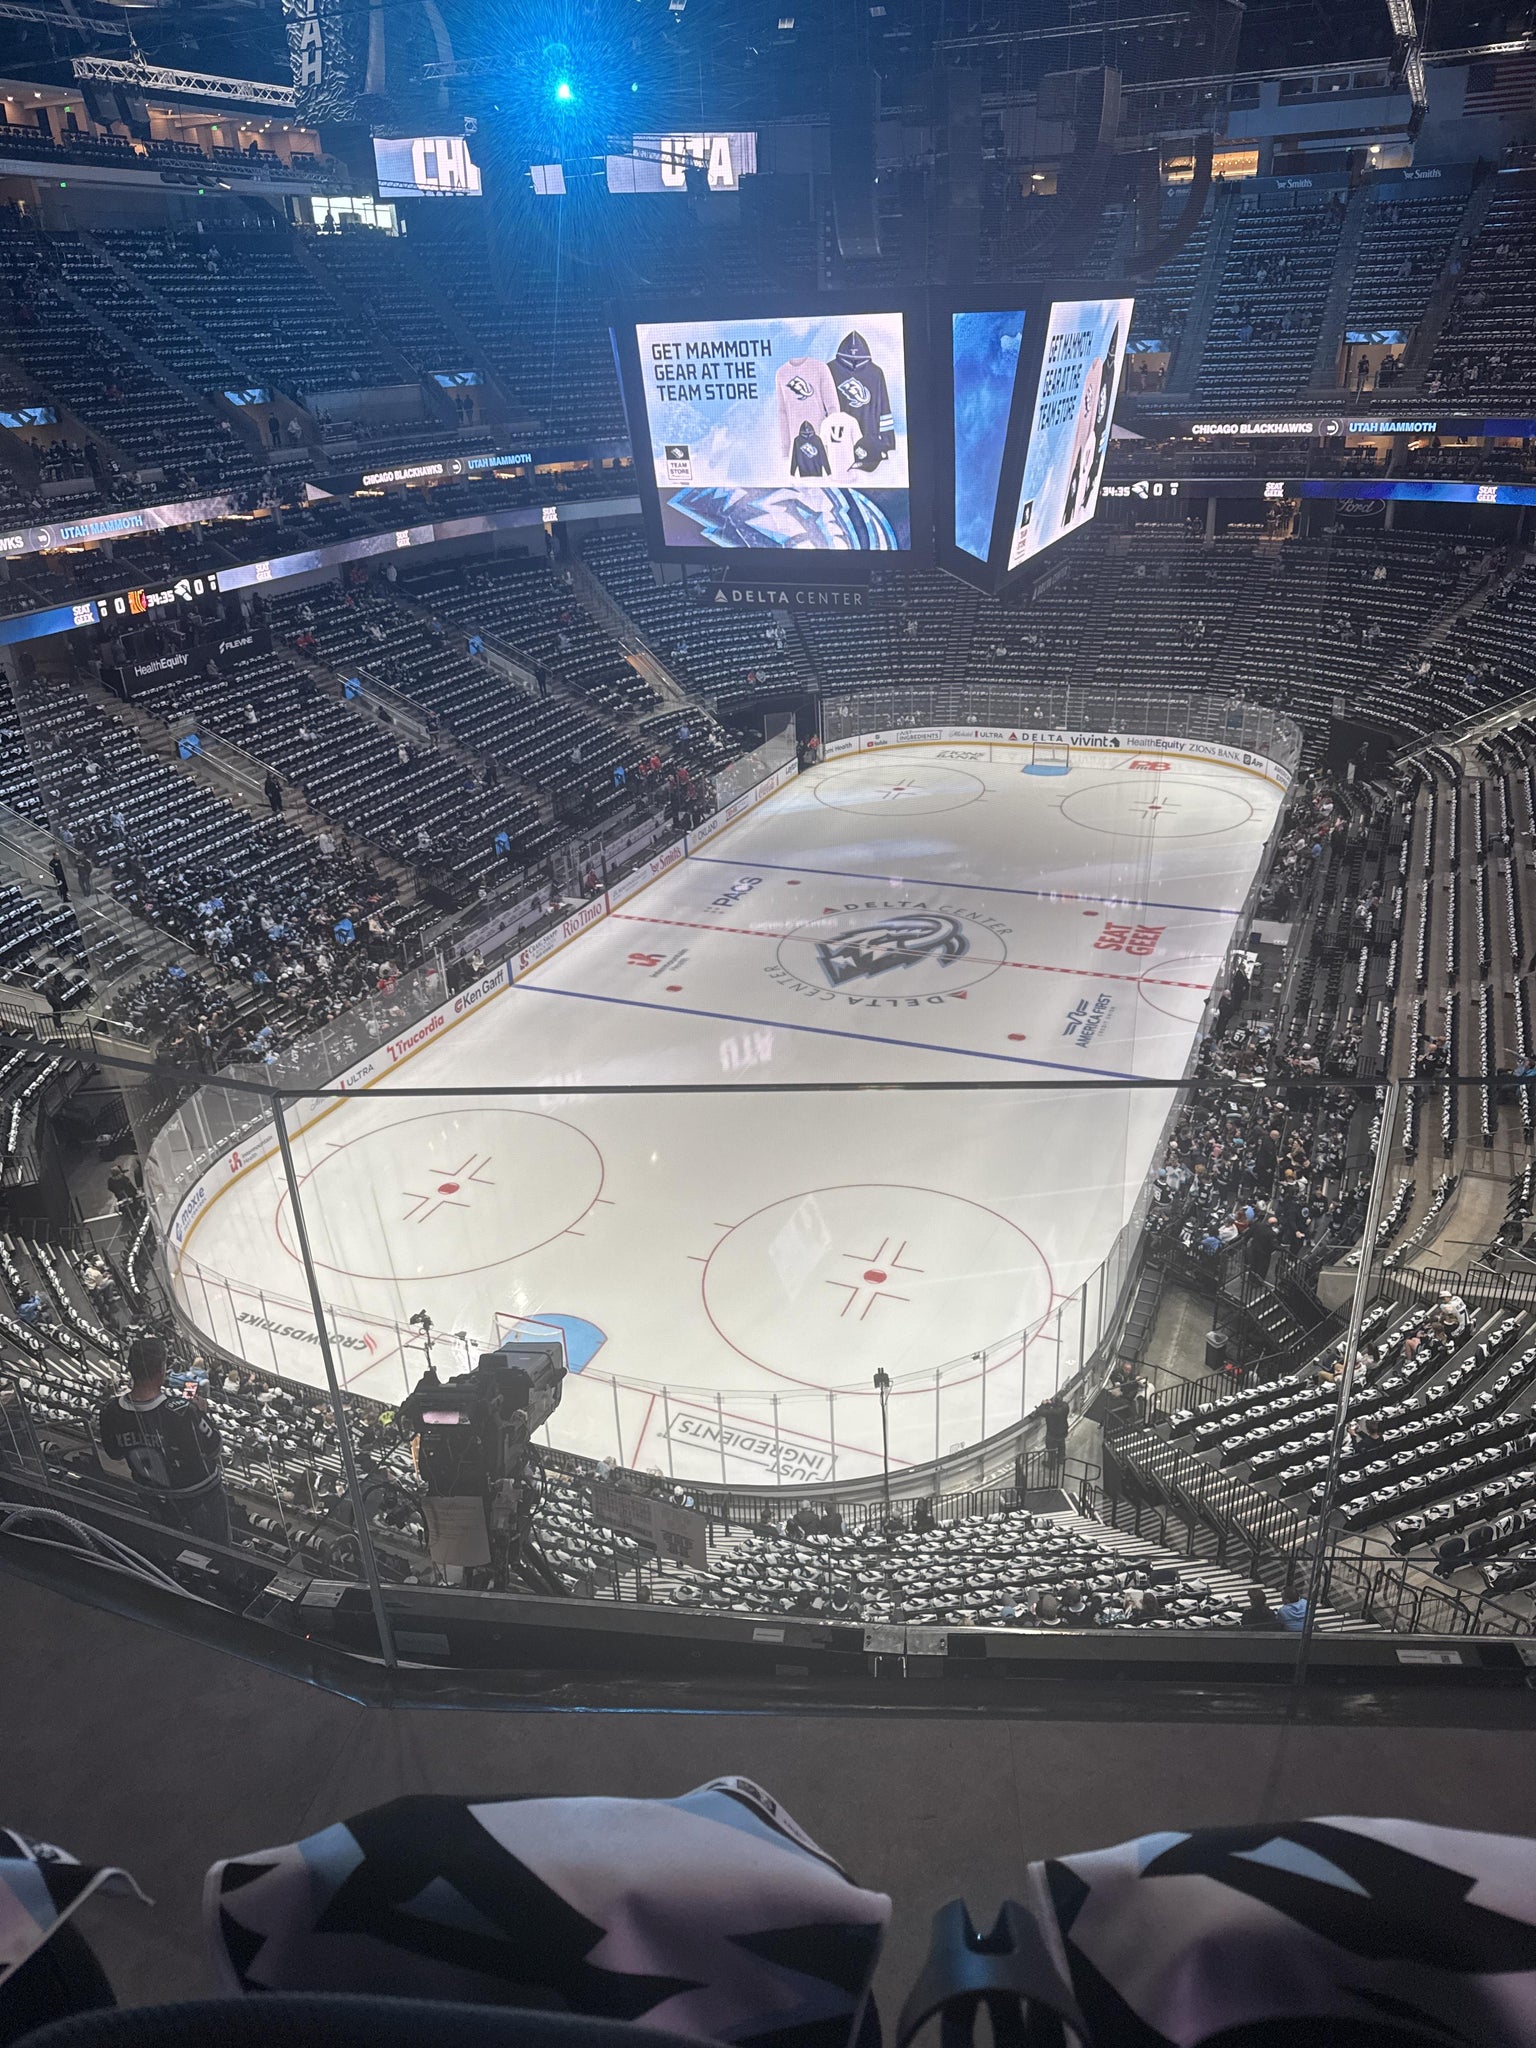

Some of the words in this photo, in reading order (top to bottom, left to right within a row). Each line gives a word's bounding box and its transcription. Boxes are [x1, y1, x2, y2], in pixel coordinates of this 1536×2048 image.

[652, 343, 681, 360] GET
[686, 339, 772, 359] MAMMOTH
[1048, 334, 1063, 363] GET
[654, 363, 697, 381] GEAR
[702, 363, 720, 379] AT
[724, 362, 756, 379] THE
[656, 384, 701, 401] TEAM
[705, 383, 758, 400] STORE
[1192, 424, 1239, 434] CHICAGO
[1240, 423, 1313, 434] BLACKHAWKS
[1349, 423, 1377, 432] UTAH
[1379, 423, 1437, 432] MAMMOTH
[468, 459, 489, 469] UTAH
[489, 453, 532, 467] MAMMOTH
[362, 471, 394, 486] CHICAGO
[394, 463, 443, 481] BLACKHAWKS
[1102, 486, 1130, 497] 34:35
[1153, 483, 1163, 496] 0
[1264, 489, 1284, 497] GEEK
[1266, 482, 1284, 490] SEAT
[1479, 486, 1498, 495] SEAT
[1336, 497, 1374, 512] Ford
[1477, 494, 1497, 502] GEEK
[60, 524, 90, 540] UTAH
[90, 515, 143, 535] MAMMOTH
[114, 597, 126, 614] 0
[147, 590, 175, 607] 34:35
[194, 579, 204, 595] 0
[732, 590, 789, 604] DELTA
[795, 591, 863, 606] CENTER
[72, 603, 90, 615] SEAT
[225, 635, 253, 650] FILEVINE
[134, 653, 189, 676] HealthEquity
[980, 731, 1003, 739] ULTRA
[1022, 732, 1063, 742] DELTA
[1127, 737, 1184, 751] HealthEquity
[1188, 743, 1216, 756] ZIONS
[1217, 749, 1240, 761] BANK
[659, 847, 682, 870] Smith's
[844, 901, 927, 910] DELTA
[939, 905, 1013, 935] CENTER
[1093, 921, 1133, 951] SEAT
[1125, 924, 1167, 956] GEEK
[463, 988, 482, 1009] Ken
[482, 968, 504, 996] Garff
[764, 965, 836, 1000] CENTER
[848, 996, 947, 1007] DELTA
[1075, 1014, 1101, 1048] AMERICA
[1096, 993, 1112, 1017] FIRST
[395, 1014, 445, 1054] Trucordia
[346, 1064, 374, 1086] ULTRA
[182, 1187, 205, 1226] moxie
[199, 1418, 213, 1438] 9
[678, 1419, 825, 1470] INGREDIENTS
[765, 1463, 818, 1481] JUST
